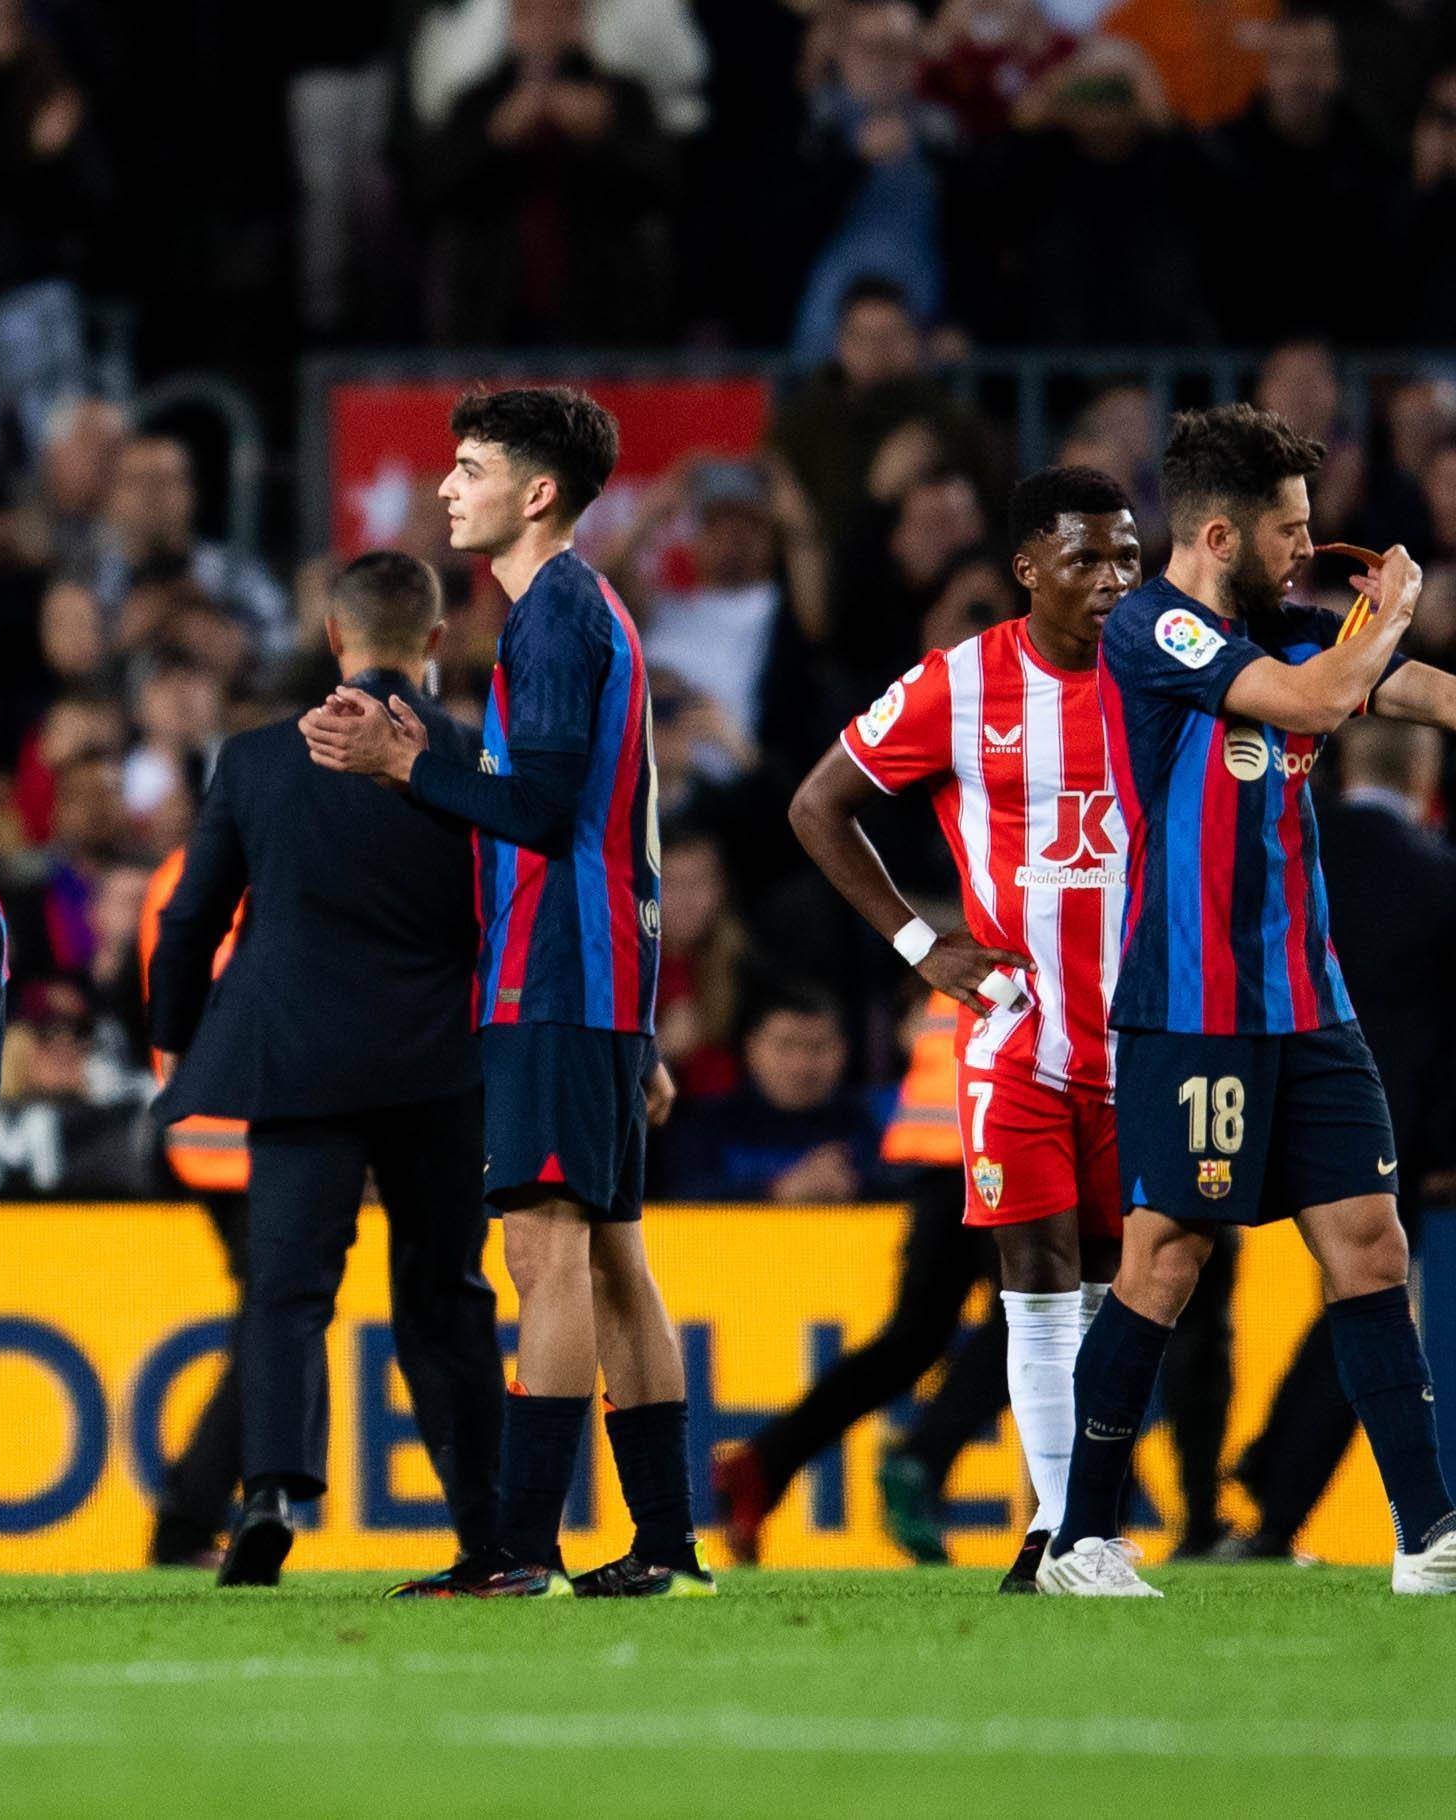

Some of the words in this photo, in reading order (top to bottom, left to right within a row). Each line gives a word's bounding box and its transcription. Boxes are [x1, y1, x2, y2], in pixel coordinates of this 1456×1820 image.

[985, 746, 1022, 754] CASTORE
[1039, 794, 1118, 863] JK
[1018, 870, 1068, 885] Khaled
[1070, 869, 1115, 886] Juffali
[967, 1080, 994, 1153] 7
[1178, 1075, 1245, 1155] 18
